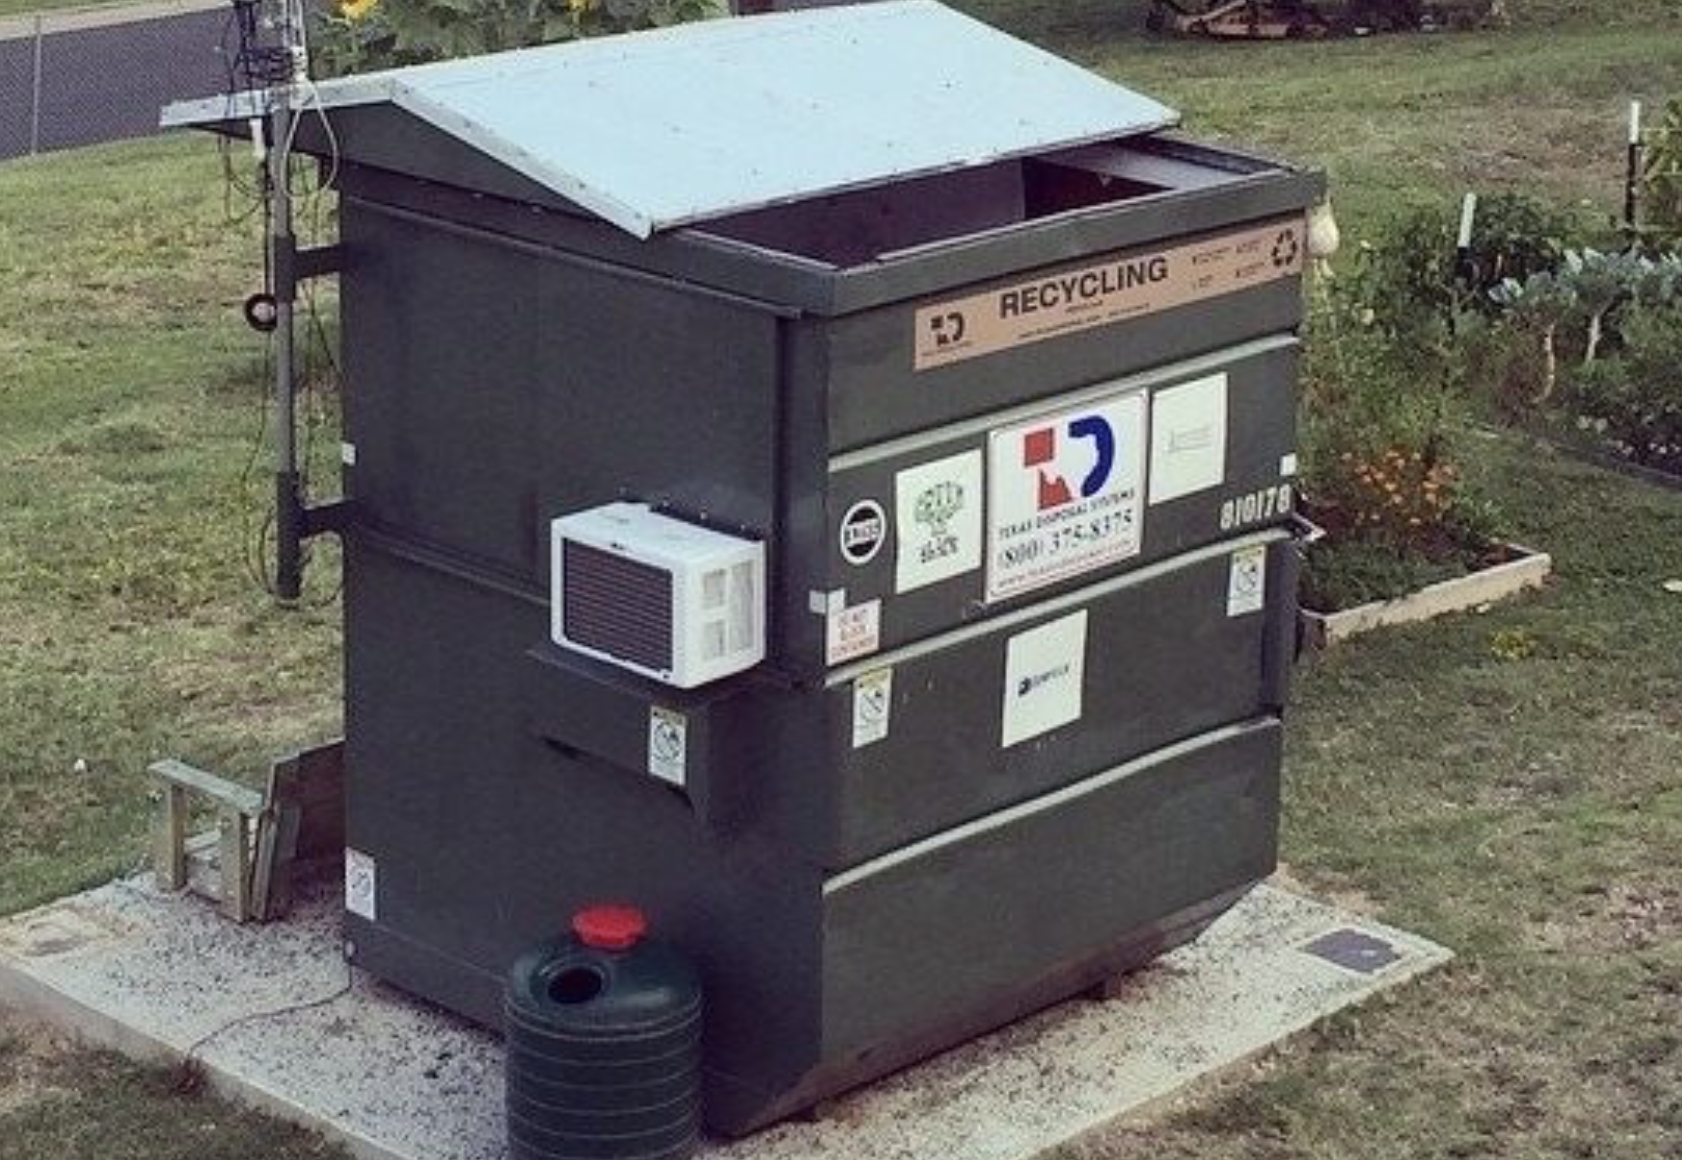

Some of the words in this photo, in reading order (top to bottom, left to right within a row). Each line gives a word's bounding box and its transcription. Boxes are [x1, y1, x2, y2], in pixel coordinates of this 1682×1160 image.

[999, 256, 1169, 319] RECYCLING
[999, 518, 1032, 540] TEXAS
[1048, 508, 1133, 556] 375-8375
